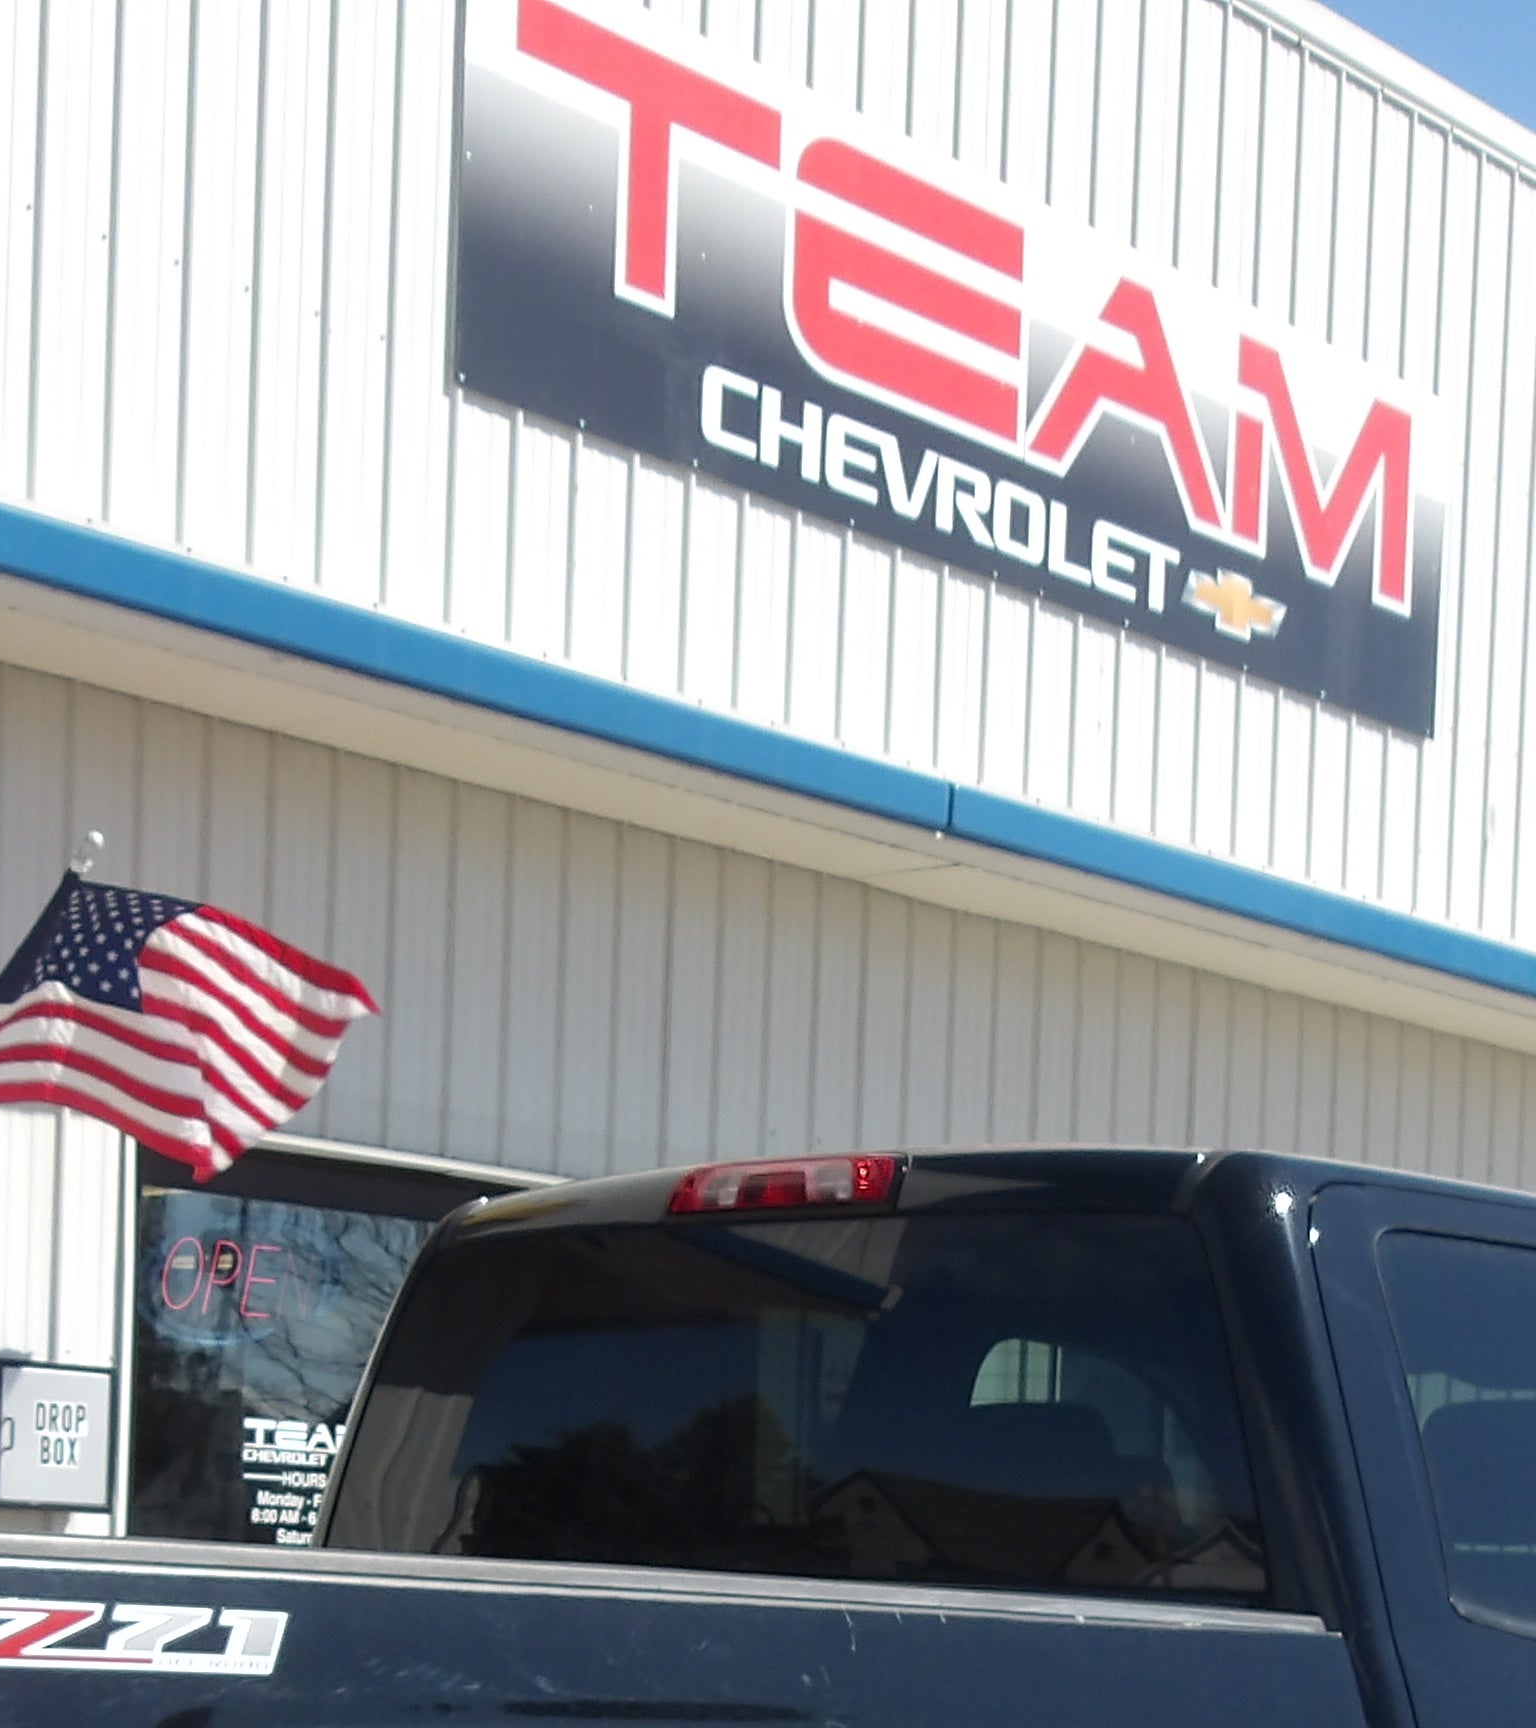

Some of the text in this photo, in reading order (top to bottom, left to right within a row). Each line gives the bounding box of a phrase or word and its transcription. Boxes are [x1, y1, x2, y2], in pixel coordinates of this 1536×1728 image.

[515, 0, 1413, 618] TEAM
[701, 364, 1180, 611] CHEVROLET
[34, 1402, 87, 1434] DROP
[39, 1435, 78, 1466] BOX
[242, 1448, 328, 1467] CHEVROLET
[282, 1471, 328, 1488] HOURS
[256, 1489, 305, 1510] Monday
[250, 1507, 278, 1524] 8:00
[278, 1509, 300, 1524] AM
[276, 1528, 313, 1545] Satur
